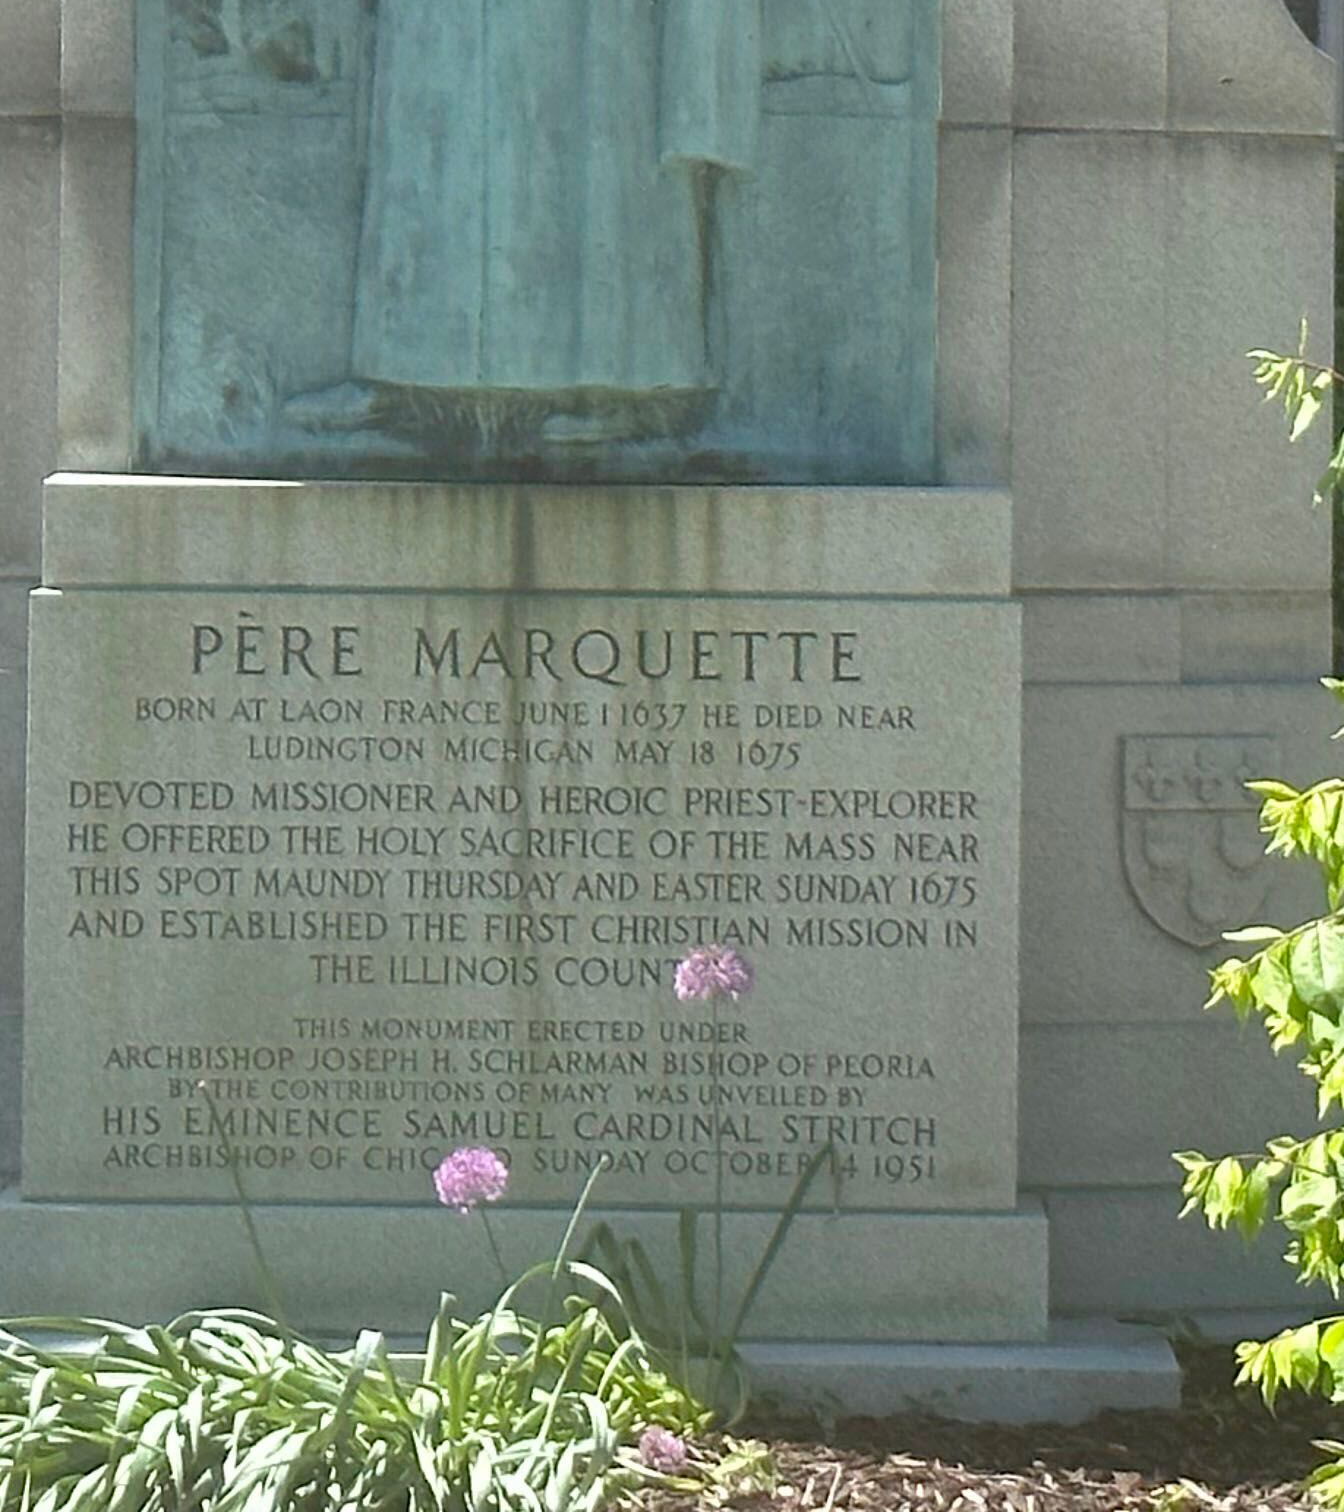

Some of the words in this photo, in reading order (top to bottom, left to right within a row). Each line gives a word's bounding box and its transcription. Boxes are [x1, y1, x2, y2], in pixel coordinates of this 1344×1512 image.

[192, 611, 362, 678] PÈRE
[415, 627, 862, 686] MARQUETTE
[136, 697, 215, 722] BORN
[232, 698, 268, 723] AT
[281, 699, 363, 724] LAON
[383, 699, 500, 725] FRANCE
[514, 701, 589, 727] JUNE
[621, 701, 687, 731] 1637
[704, 704, 739, 727] HE
[755, 704, 822, 728] DIED
[838, 705, 915, 730] NEAR
[248, 736, 424, 762] LUDINGTON
[444, 737, 594, 764] MICHIGAN
[615, 741, 675, 765] MAY
[691, 740, 715, 764] 18
[736, 742, 801, 770] 1675
[68, 781, 234, 811] DEVOTED
[251, 783, 436, 814] MISSIONER
[448, 785, 522, 814] AND
[541, 787, 666, 816] HEROIC
[685, 789, 978, 820] PRIEST-EXPLORER
[68, 824, 108, 852] HE
[122, 824, 270, 854] OFFERED
[282, 827, 343, 854] THE
[358, 827, 446, 856] HOLY
[460, 828, 634, 859] SACRIFICE
[649, 829, 697, 859] OF
[707, 831, 770, 860] THE
[785, 832, 876, 861] MASS
[894, 833, 980, 863] NEAR
[69, 866, 140, 896] THIS
[157, 866, 241, 897] SPOT
[255, 868, 388, 899] MAUNDY
[405, 869, 561, 901] THURSDAY
[573, 872, 638, 901] AND
[653, 873, 765, 903] EASTER
[777, 874, 898, 904] SUNDAY
[909, 875, 977, 908] 1675
[68, 910, 144, 938] AND
[160, 911, 387, 942] ESTABLISHED
[402, 913, 467, 942] THE
[484, 914, 577, 944] FIRST
[591, 915, 769, 946] CHRISTIAN
[787, 918, 928, 948] MISSION
[945, 920, 977, 948] IN
[309, 954, 374, 984] THE
[389, 955, 538, 987] ILLINOIS
[556, 957, 731, 987] COUN
[293, 1018, 350, 1038] THIS
[362, 1019, 513, 1040] MONUMENT
[527, 1021, 644, 1043] ERECTED
[660, 1022, 750, 1044] UNDER
[104, 1046, 294, 1071] ARCHBISHOP
[306, 1048, 418, 1073] JOSEPH
[433, 1050, 457, 1073] H.
[468, 1050, 647, 1075] SCHLARMAN
[662, 1052, 769, 1077] BISHOP
[777, 1053, 817, 1078] OF
[827, 1054, 935, 1079] PEORIA
[168, 1079, 201, 1099] BY
[213, 1079, 257, 1100] THE
[272, 1080, 485, 1103] CONTRIBUTIONS
[496, 1082, 530, 1103] OF
[541, 1084, 612, 1104] MANY
[635, 1085, 689, 1105] WAS
[699, 1086, 826, 1106] UNVEILED
[838, 1087, 865, 1107] BY
[103, 1107, 161, 1136] HIS
[185, 1108, 382, 1138] EMINENCE
[403, 1110, 555, 1140] SAMUEL
[573, 1112, 762, 1144] CARDINAL
[782, 1116, 936, 1146] STRITCH
[103, 1144, 295, 1169] ARCHBISHOP
[310, 1146, 349, 1170] OF
[362, 1146, 512, 1172] CHICO
[534, 1149, 651, 1175] SUNDAY
[665, 1151, 813, 1177] OCTOBER
[874, 1154, 935, 1184] 1951
